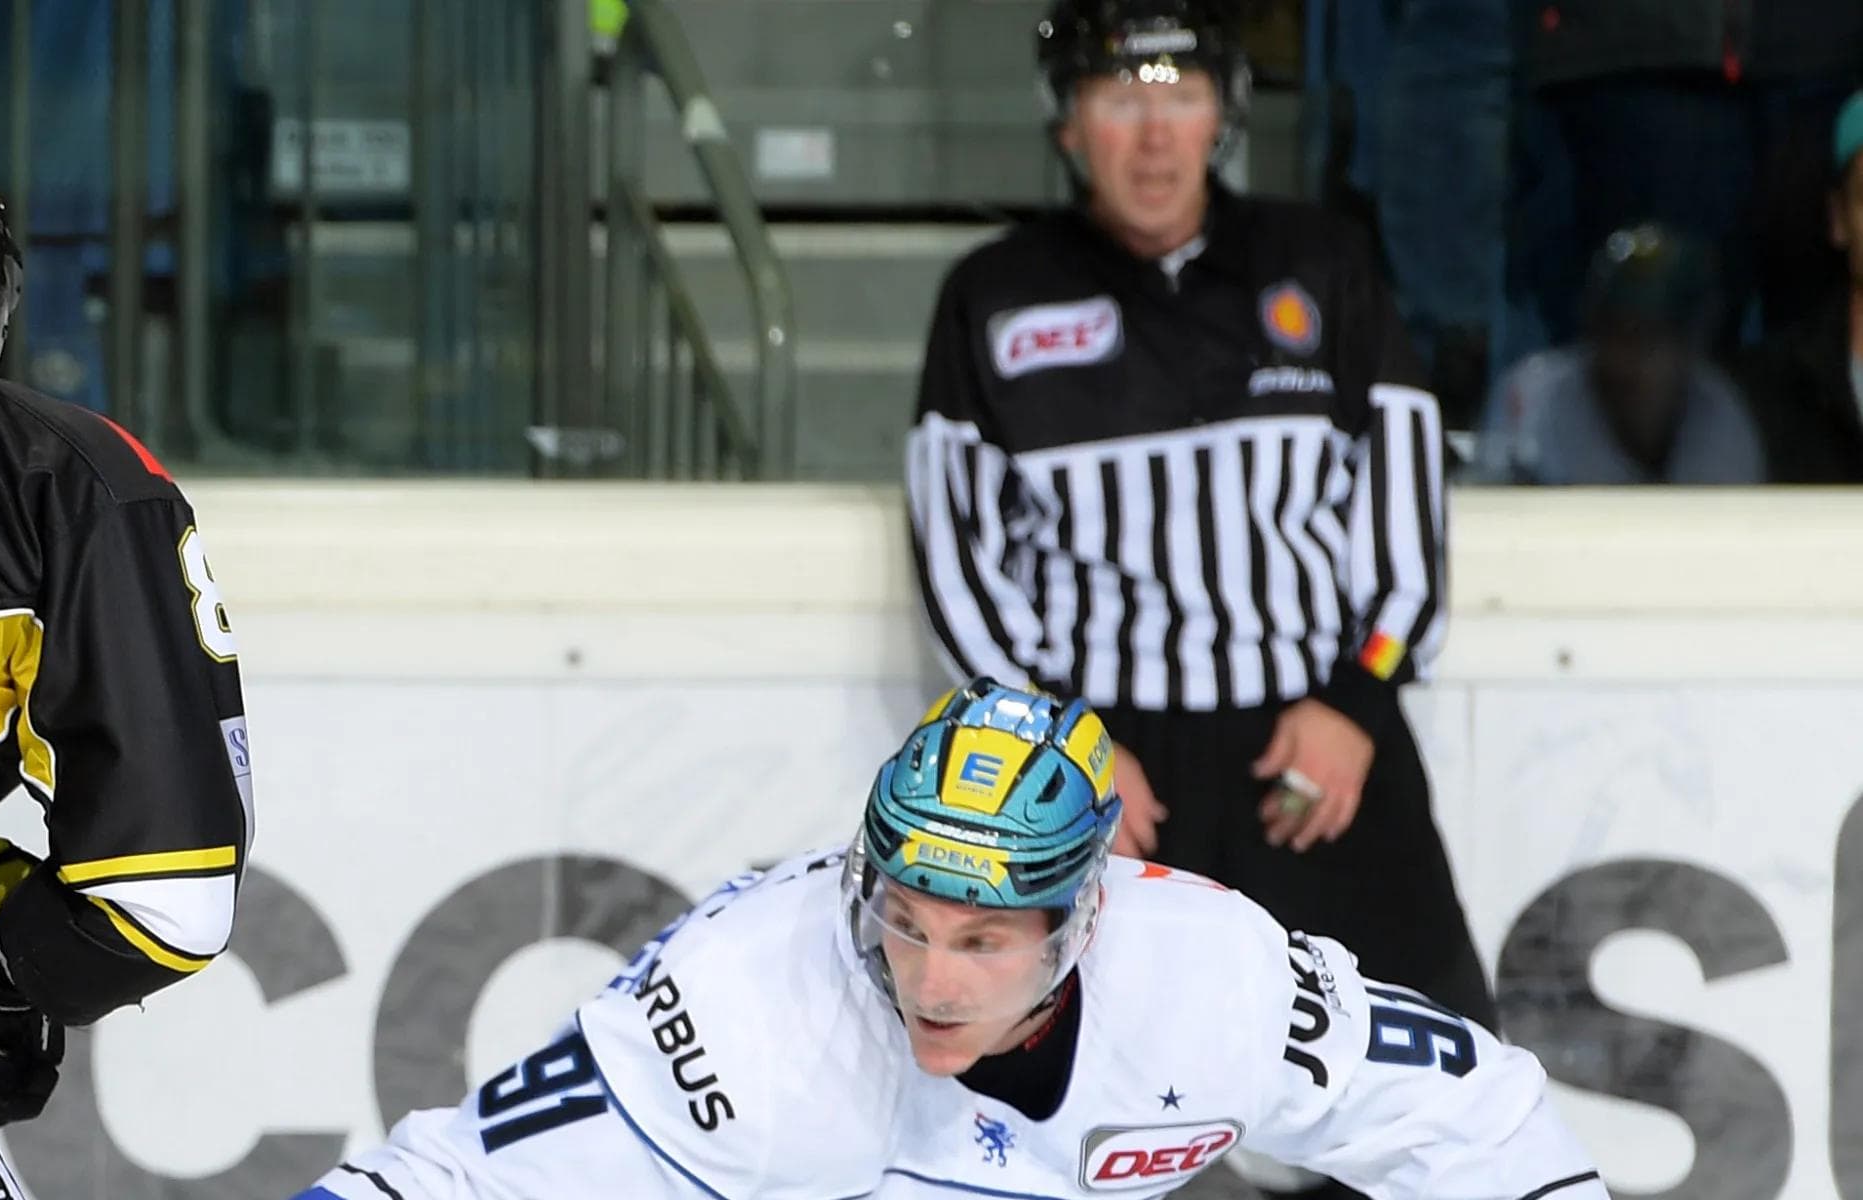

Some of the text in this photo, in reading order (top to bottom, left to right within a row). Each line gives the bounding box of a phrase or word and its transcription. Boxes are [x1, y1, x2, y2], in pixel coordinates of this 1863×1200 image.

[916, 841, 994, 876] EDEKA
[478, 1028, 609, 1155] 91
[634, 960, 737, 1133] RBUS
